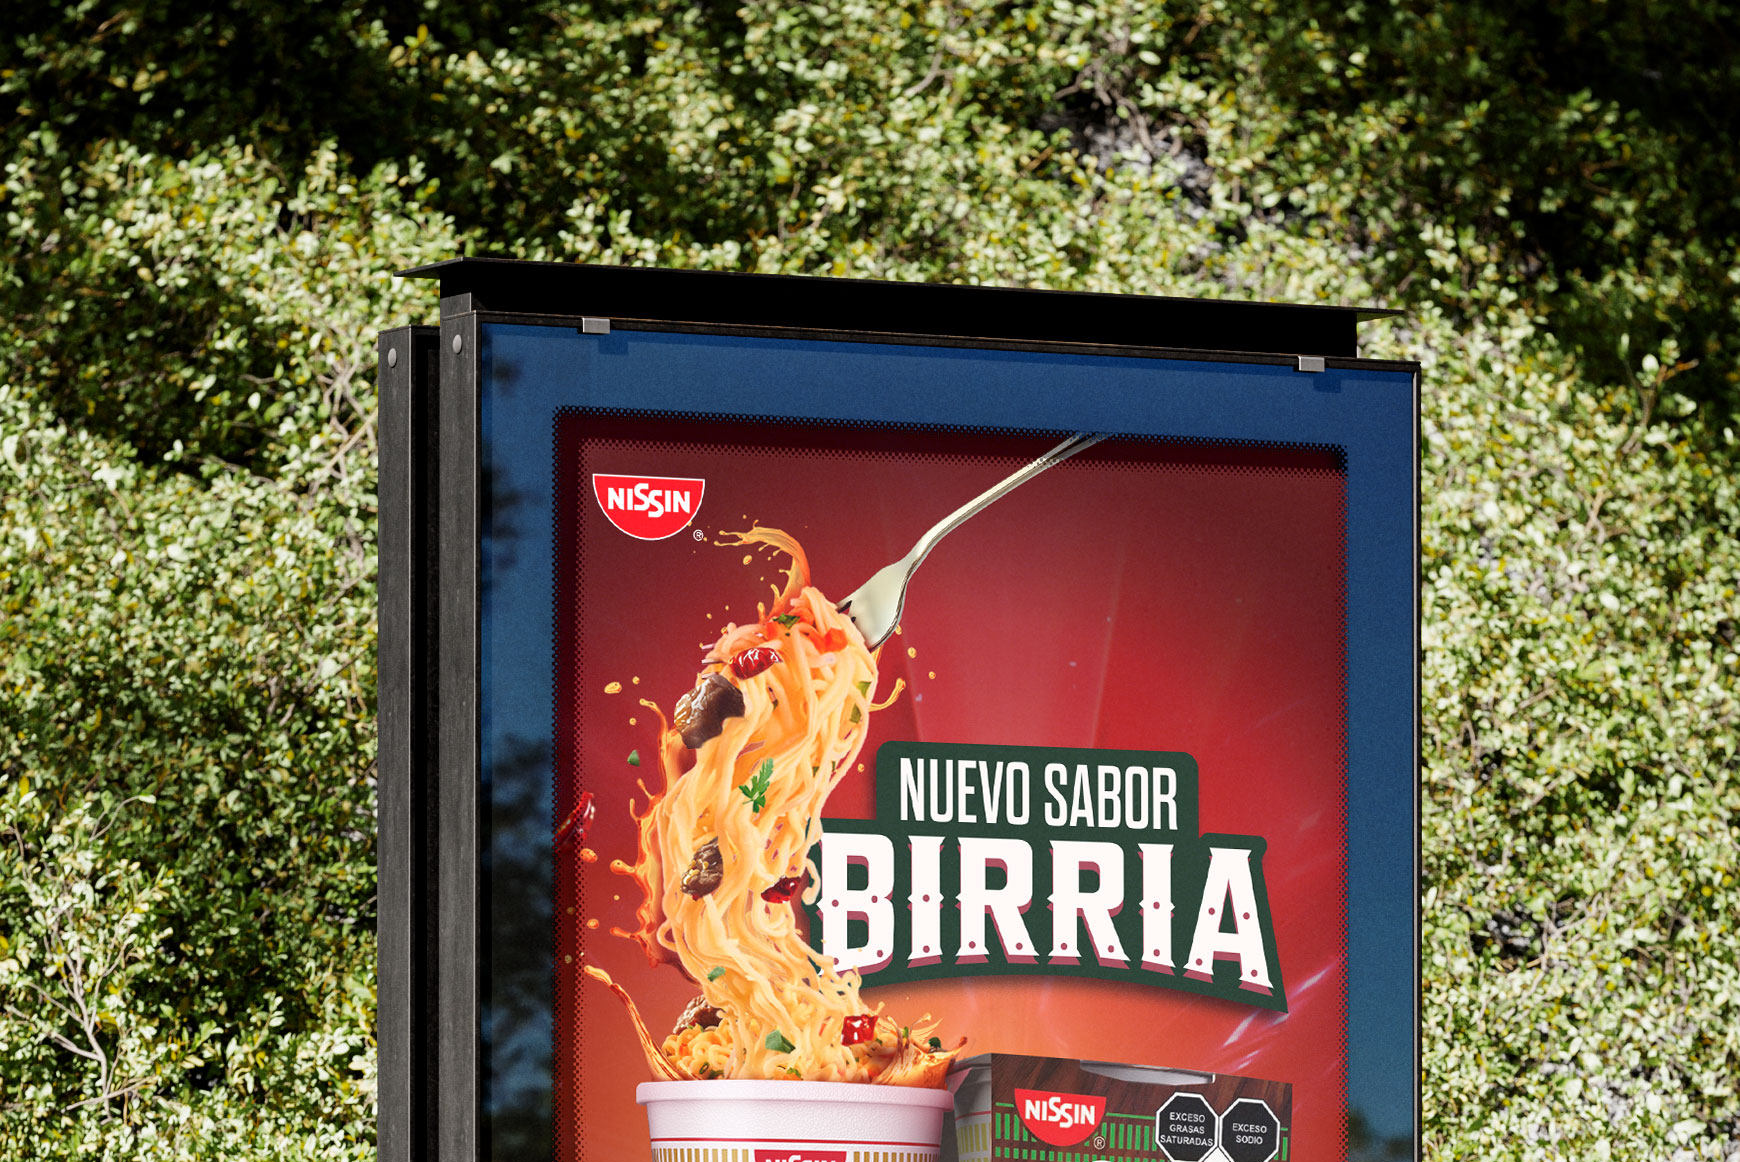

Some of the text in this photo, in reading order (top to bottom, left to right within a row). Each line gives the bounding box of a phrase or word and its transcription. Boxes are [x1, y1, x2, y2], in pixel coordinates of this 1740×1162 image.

[608, 483, 691, 517] NISSIN
[900, 757, 1178, 831] NUEVO SABOR
[814, 831, 1275, 992] BIRRIA
[1025, 1097, 1096, 1129] NISSIN
[1169, 1111, 1206, 1123] EXCESO
[1169, 1123, 1205, 1135] GRASAS
[1232, 1122, 1268, 1134] EXCESO
[1160, 1134, 1214, 1147] SATURADAS
[1235, 1134, 1264, 1145] SODIO
